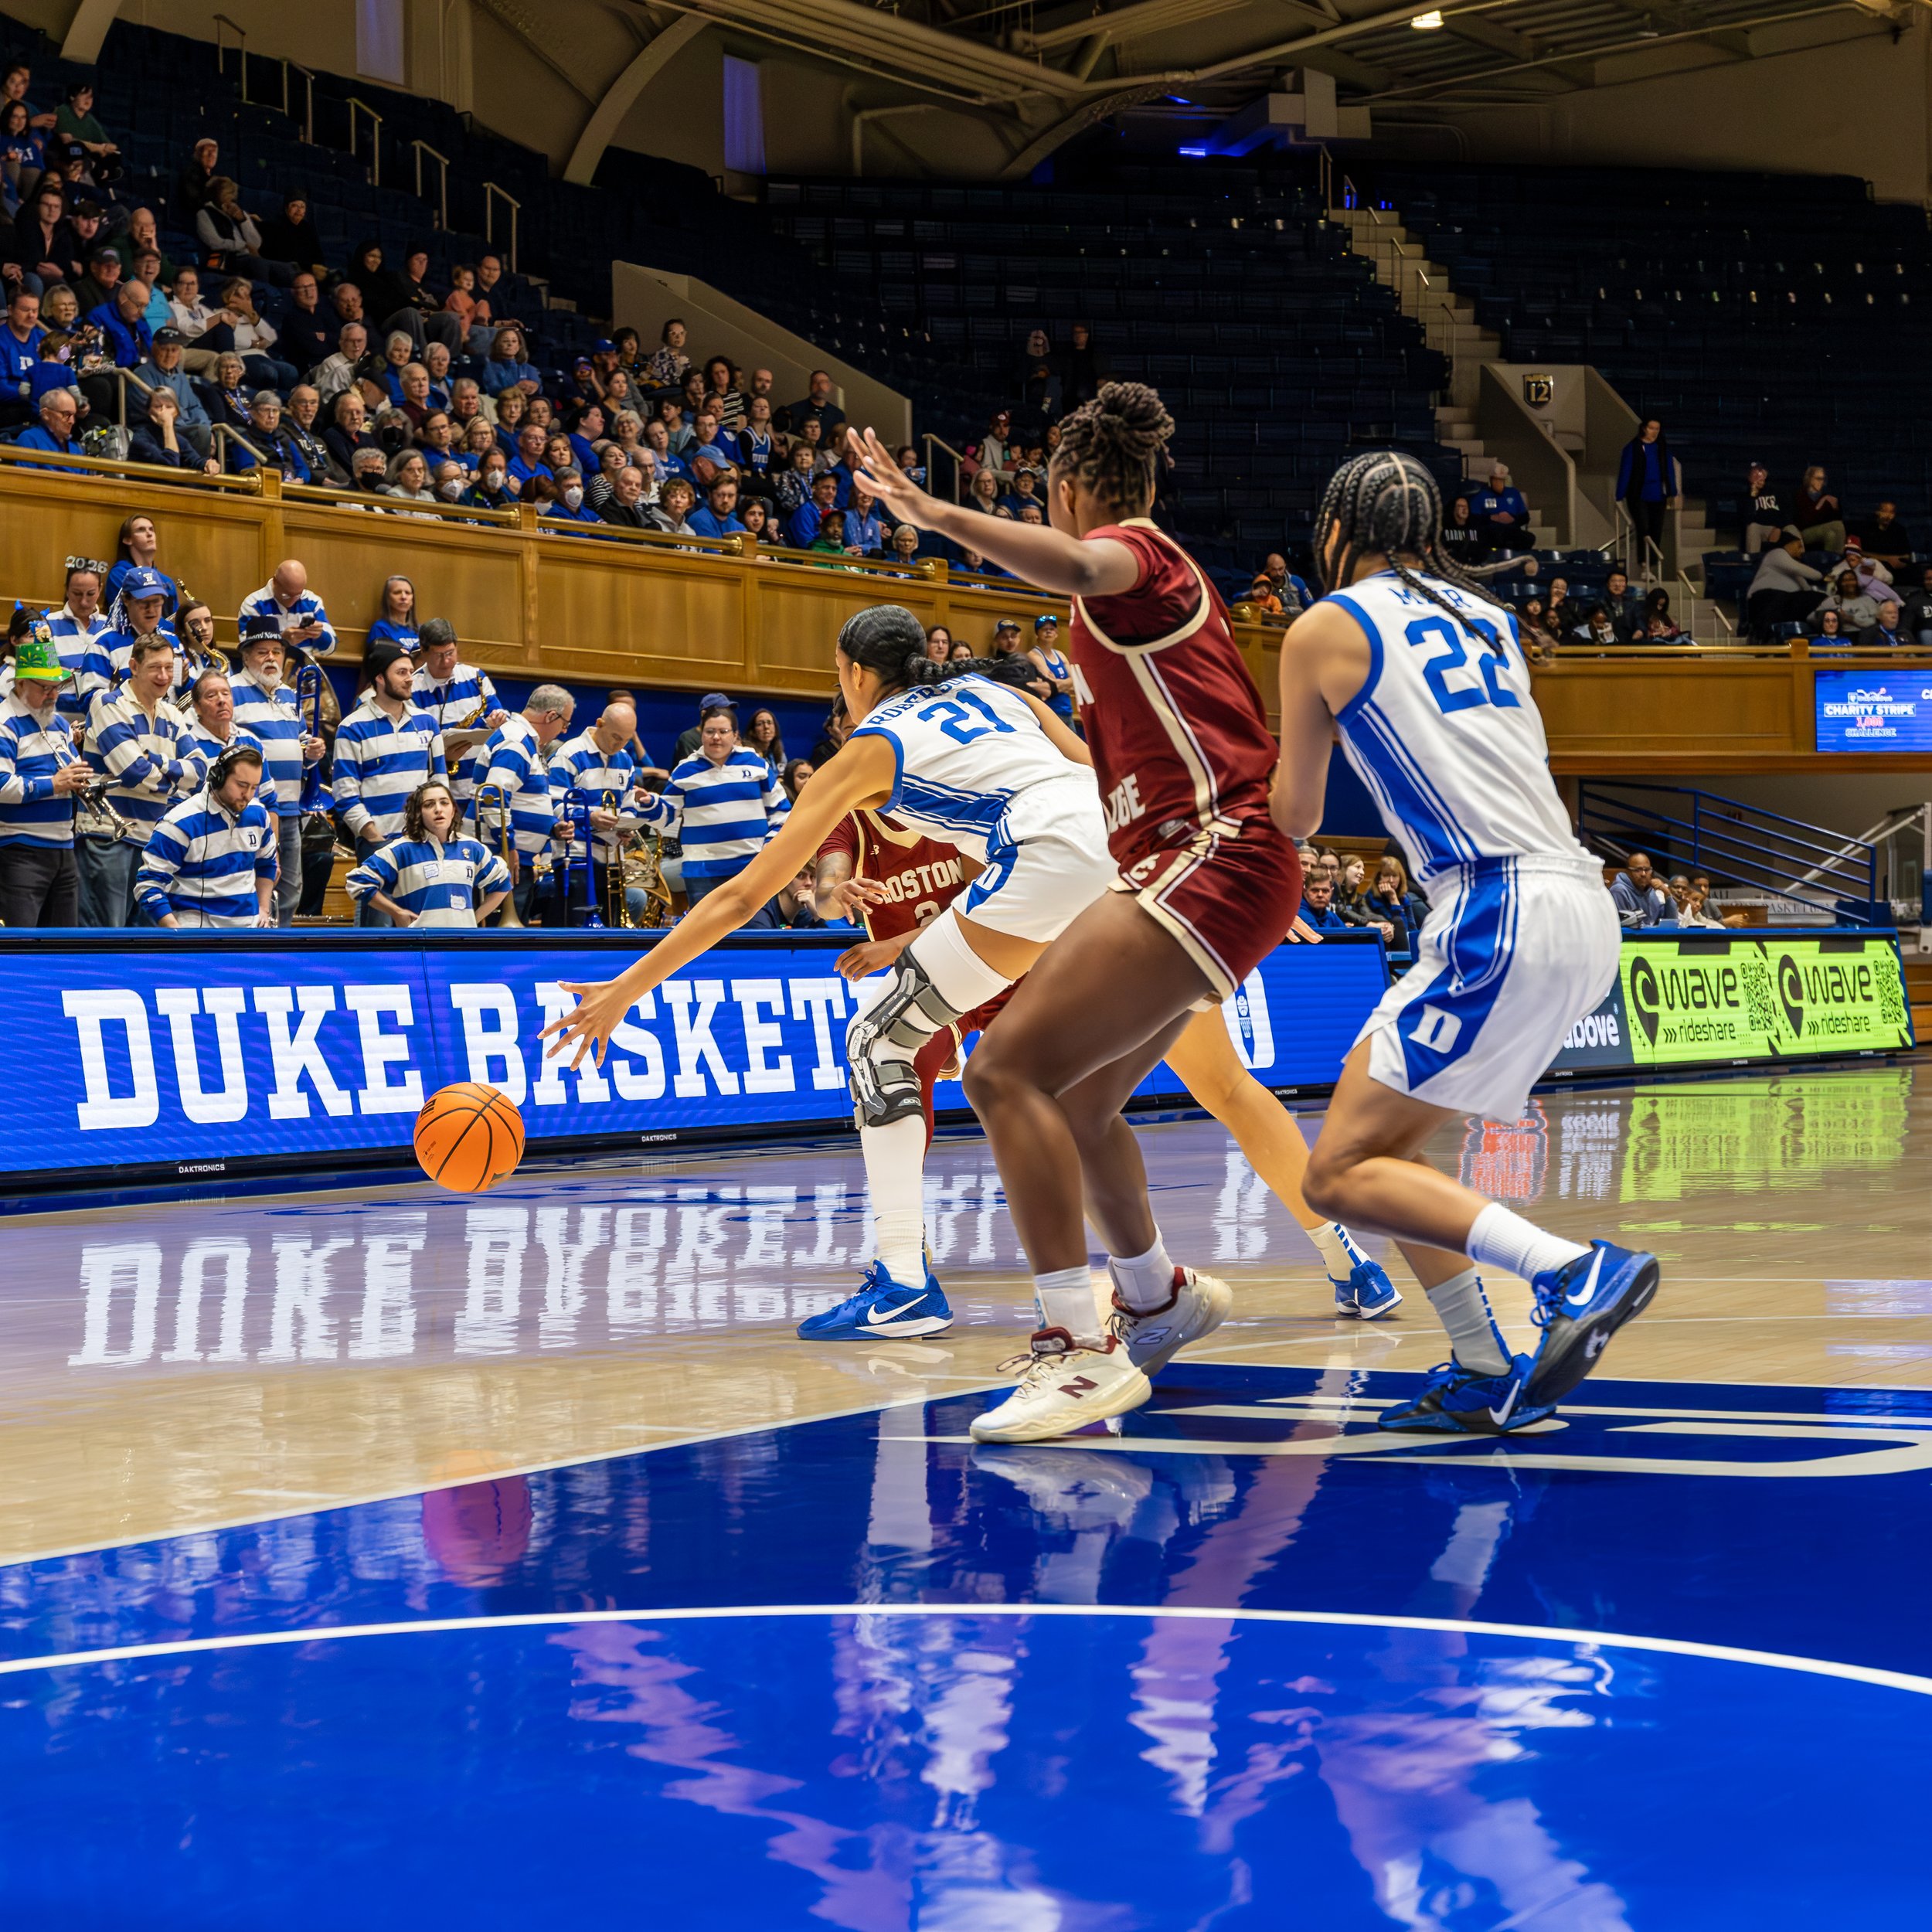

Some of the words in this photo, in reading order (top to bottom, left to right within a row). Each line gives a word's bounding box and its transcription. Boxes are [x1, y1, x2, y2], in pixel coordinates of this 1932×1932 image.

[1530, 383, 1549, 402] 12
[65, 555, 109, 573] 2026
[1388, 587, 1472, 607] MR
[1405, 616, 1520, 714] 22
[917, 689, 1018, 744] 21
[1825, 705, 1874, 716] CHARITY
[1876, 705, 1914, 716] STRIPE
[1845, 728, 1896, 737] CHALLENGE
[1407, 1002, 1463, 1054] D
[1679, 1019, 1736, 1044] rideshare
[1821, 1011, 1870, 1036] rideshare
[61, 985, 424, 1130] DUKE
[449, 976, 968, 1109] BASKET
[641, 1133, 677, 1142] DAKTRONICS
[178, 1163, 226, 1174] DAKTRONICS
